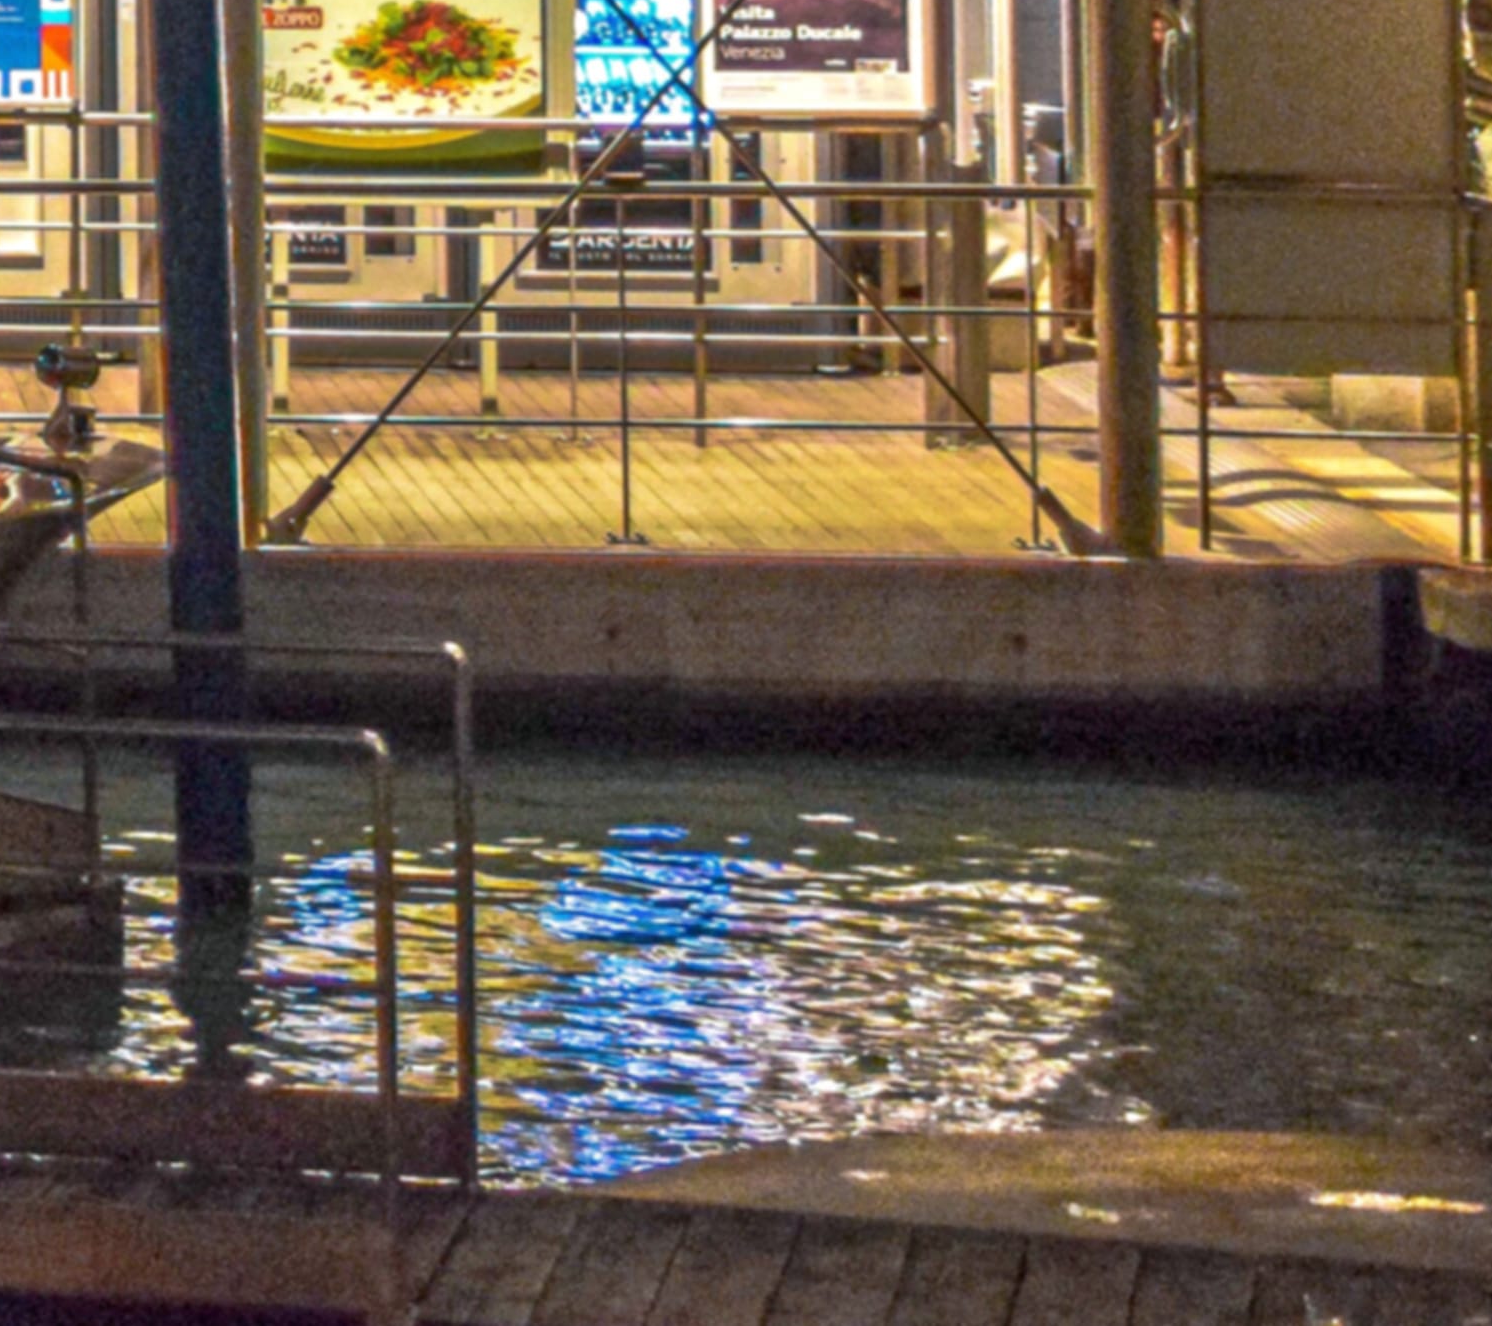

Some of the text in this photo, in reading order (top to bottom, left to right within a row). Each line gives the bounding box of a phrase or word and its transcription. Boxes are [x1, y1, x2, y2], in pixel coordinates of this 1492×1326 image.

[719, 24, 863, 40] Palazzo Ducale
[720, 46, 786, 61] Venezia
